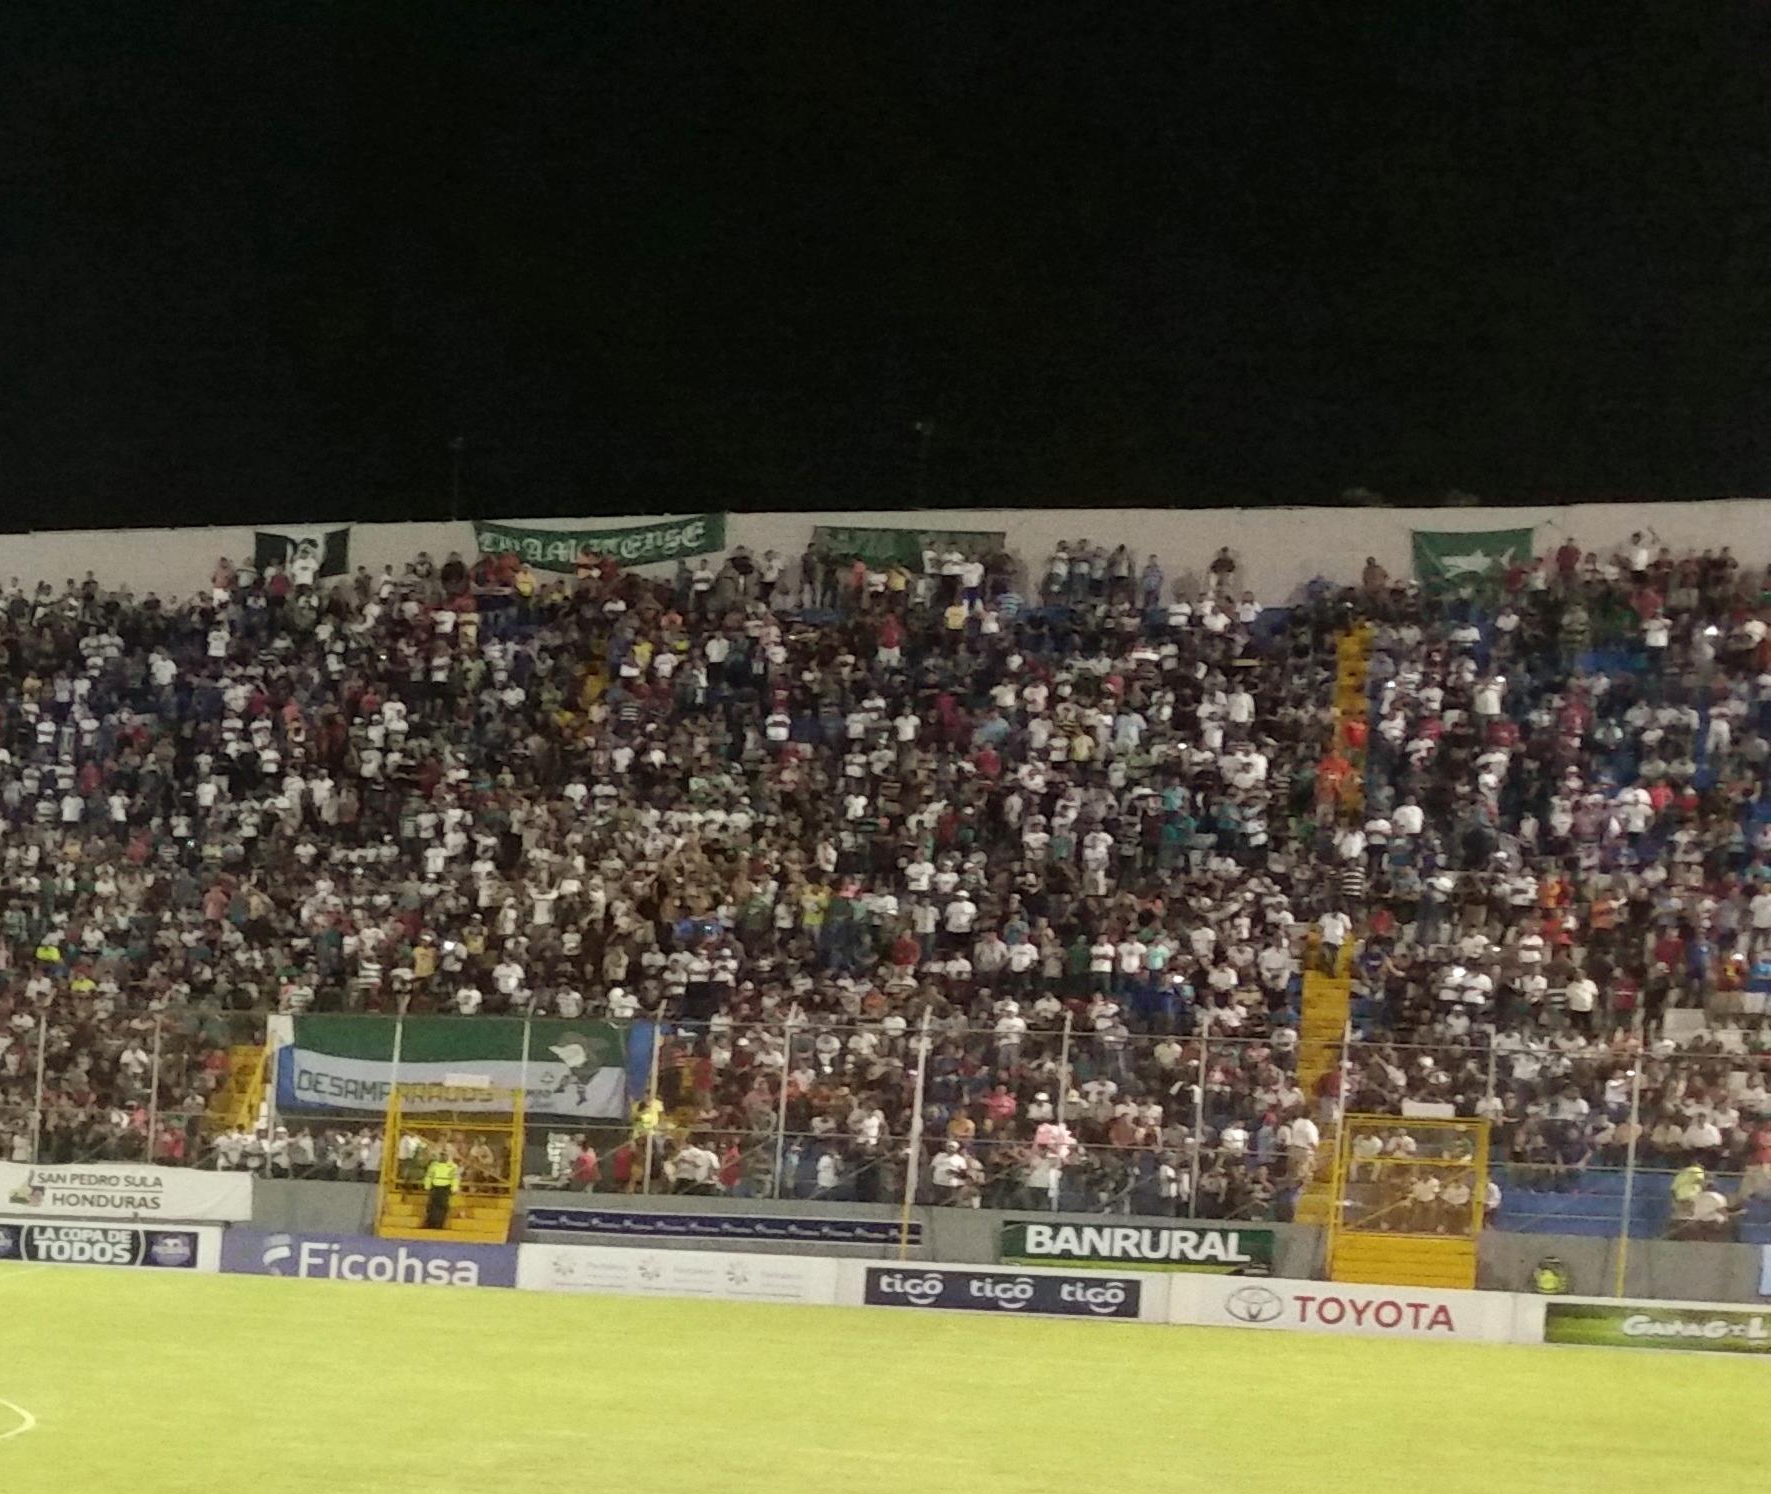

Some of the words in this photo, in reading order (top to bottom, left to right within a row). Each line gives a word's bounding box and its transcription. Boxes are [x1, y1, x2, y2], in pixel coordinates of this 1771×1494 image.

[38, 1171, 67, 1185] SAN
[69, 1172, 121, 1188] PEDRO
[123, 1174, 164, 1188] SULA
[51, 1192, 161, 1210] HONDURAS
[33, 1226, 58, 1240] LA
[59, 1228, 107, 1242] COPA
[108, 1229, 133, 1243] DE
[1025, 1224, 1252, 1263] BANRURAL
[33, 1240, 133, 1264] TODOS
[298, 1241, 480, 1287] Ficohsa
[1293, 1295, 1455, 1331] TOYOTA
